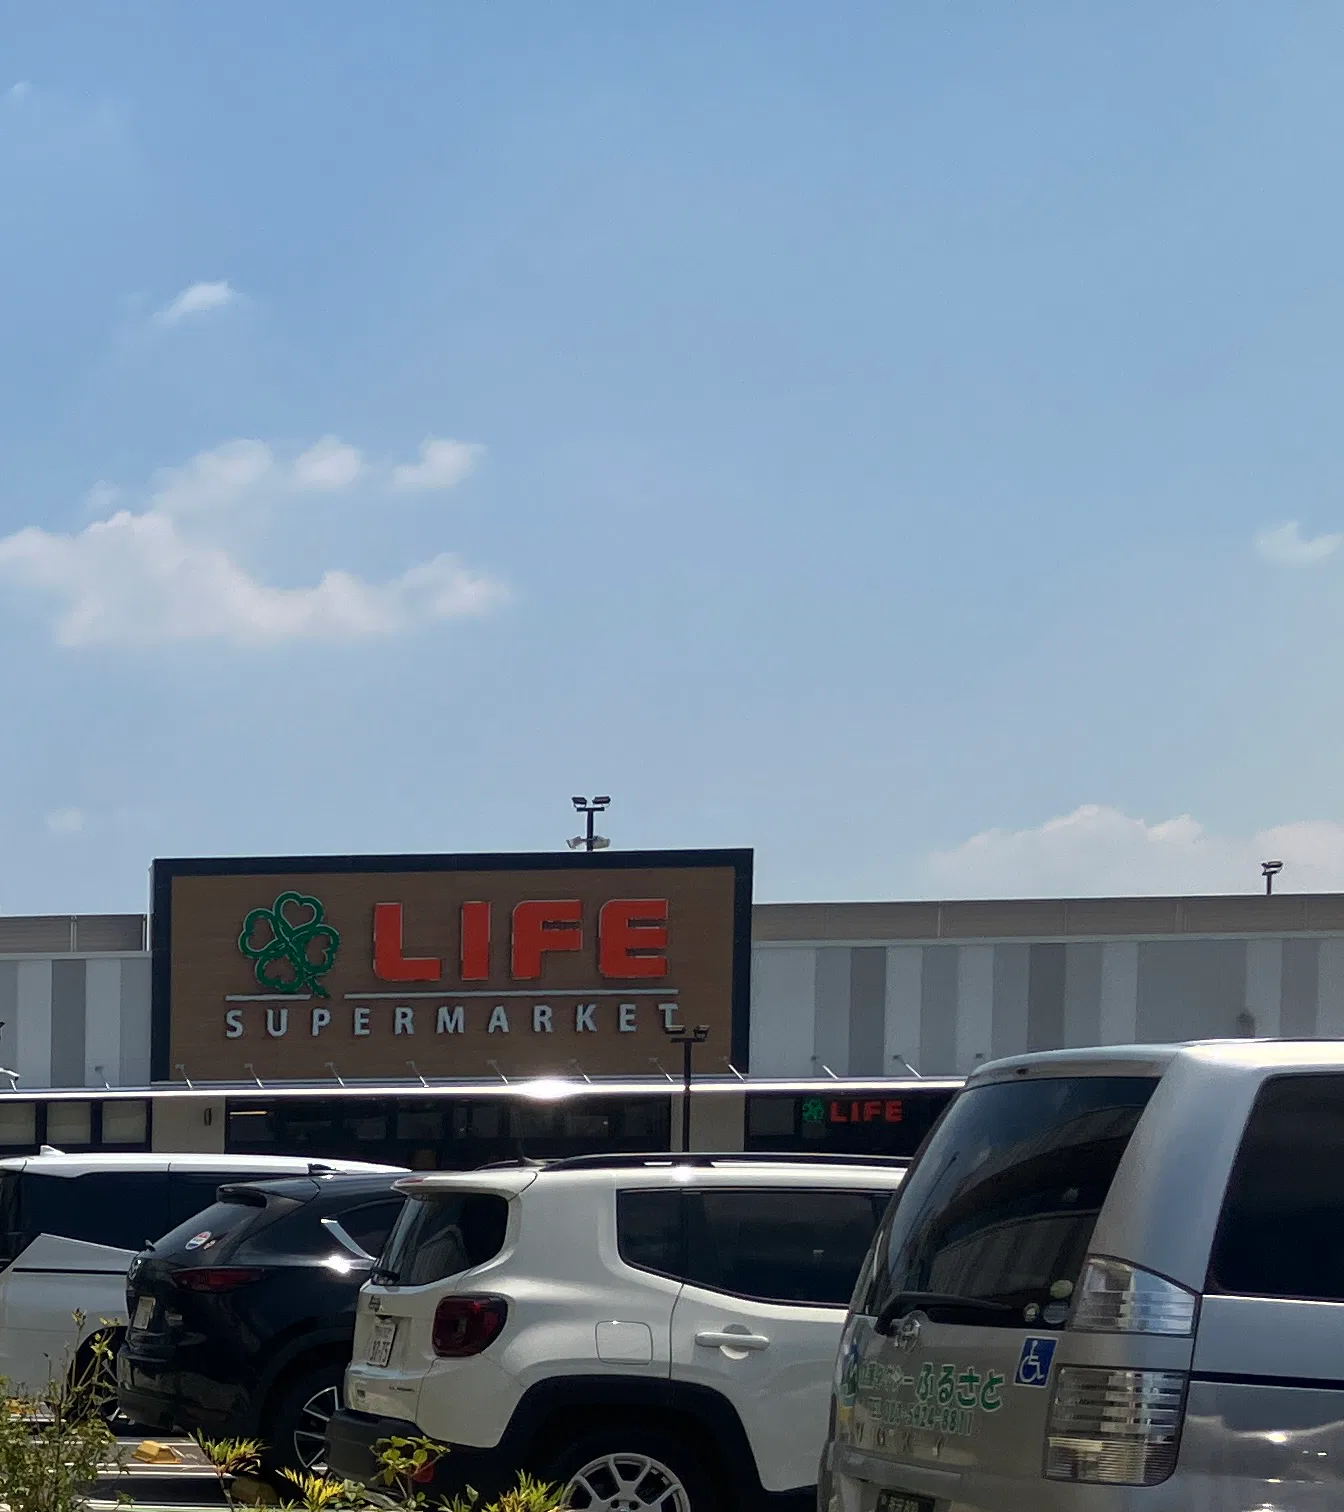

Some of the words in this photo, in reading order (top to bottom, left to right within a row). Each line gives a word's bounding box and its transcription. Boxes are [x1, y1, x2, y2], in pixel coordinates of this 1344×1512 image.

[372, 897, 670, 982] LIFE
[225, 1002, 679, 1039] SUPERMARKET
[829, 1099, 905, 1124] LIFE
[915, 1361, 1004, 1412] ふるさと
